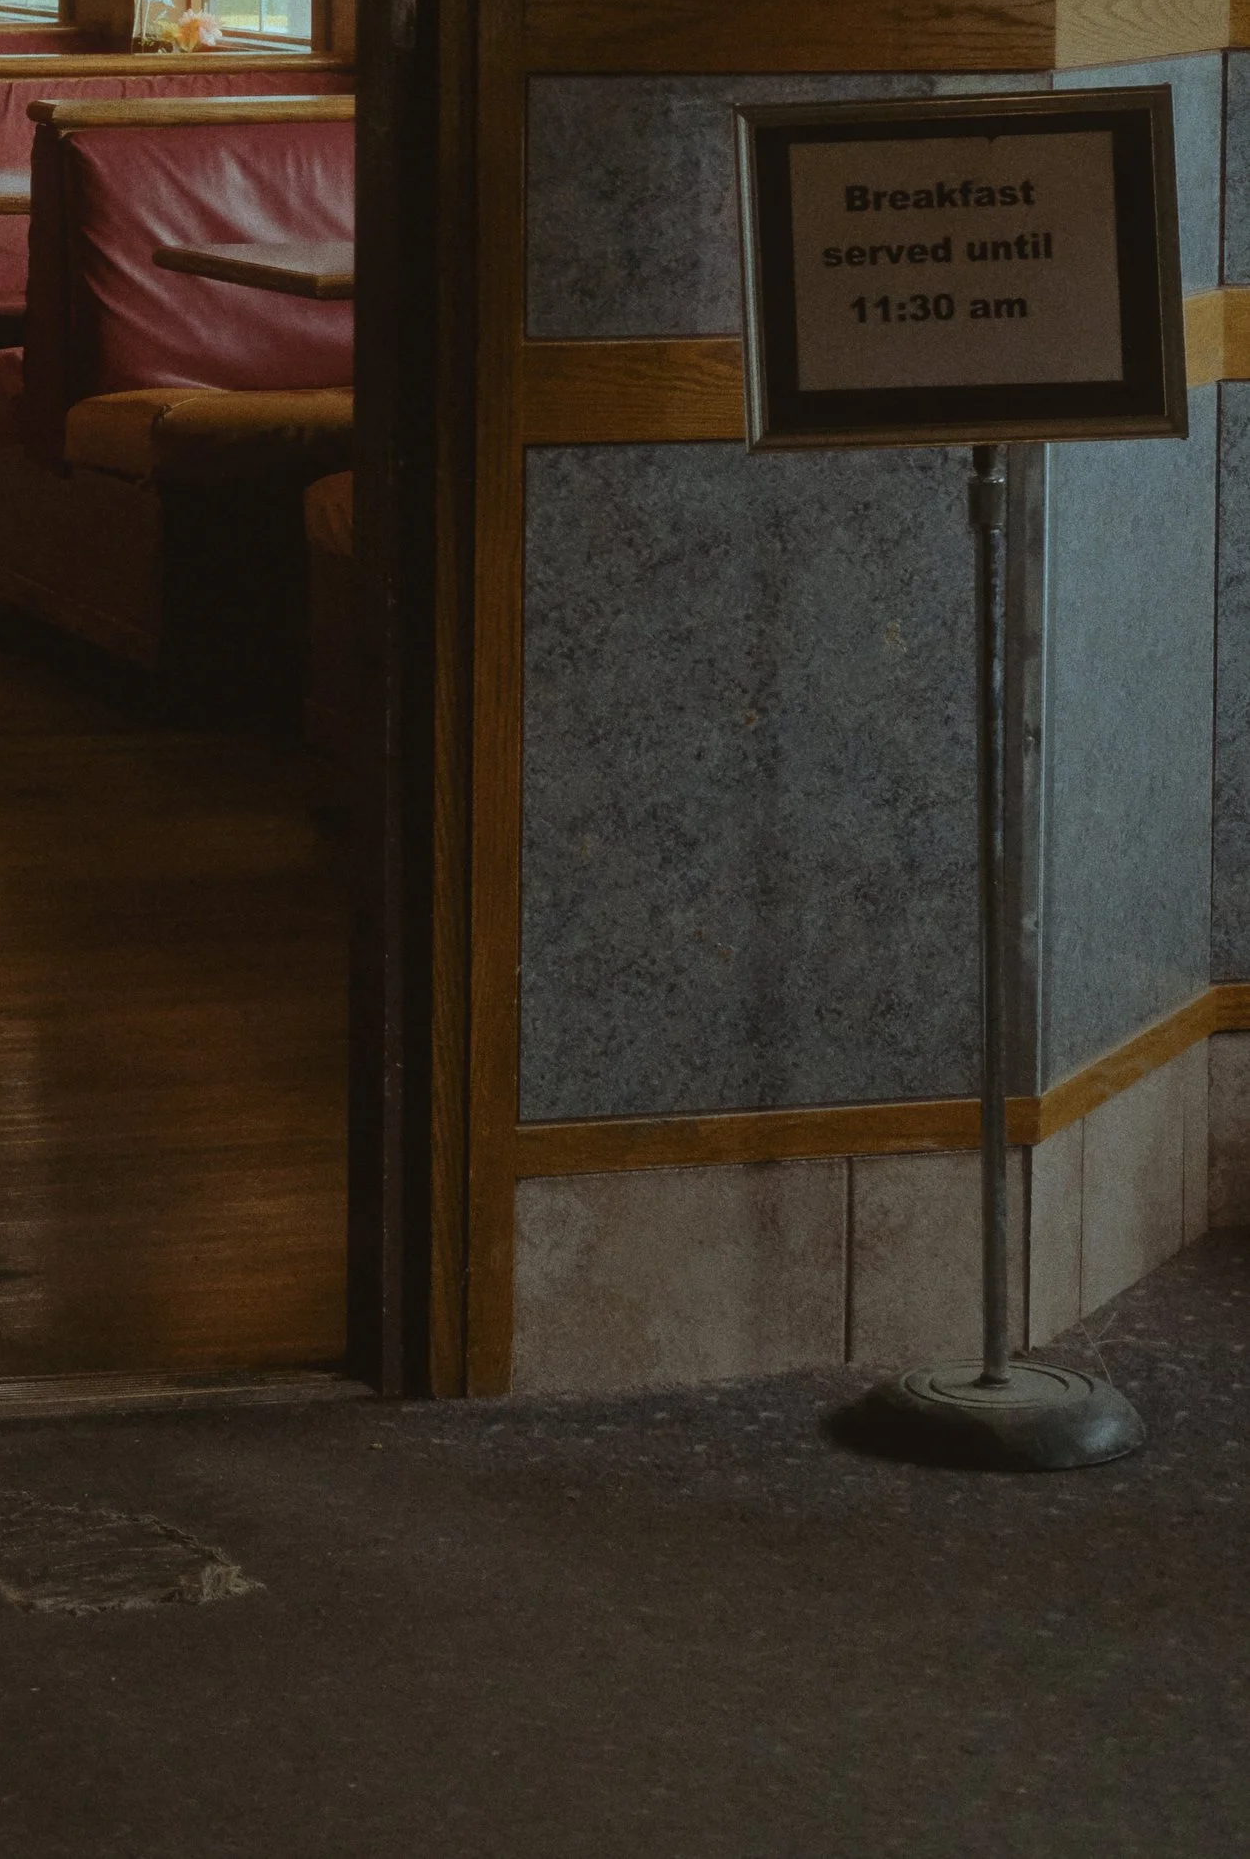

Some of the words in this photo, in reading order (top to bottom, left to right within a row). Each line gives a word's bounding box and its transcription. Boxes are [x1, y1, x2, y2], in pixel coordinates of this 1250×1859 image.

[845, 178, 1036, 212] Breakfast
[822, 236, 952, 267] served
[966, 233, 1053, 262] until
[850, 293, 955, 324] 11:30
[969, 297, 1028, 320] am
